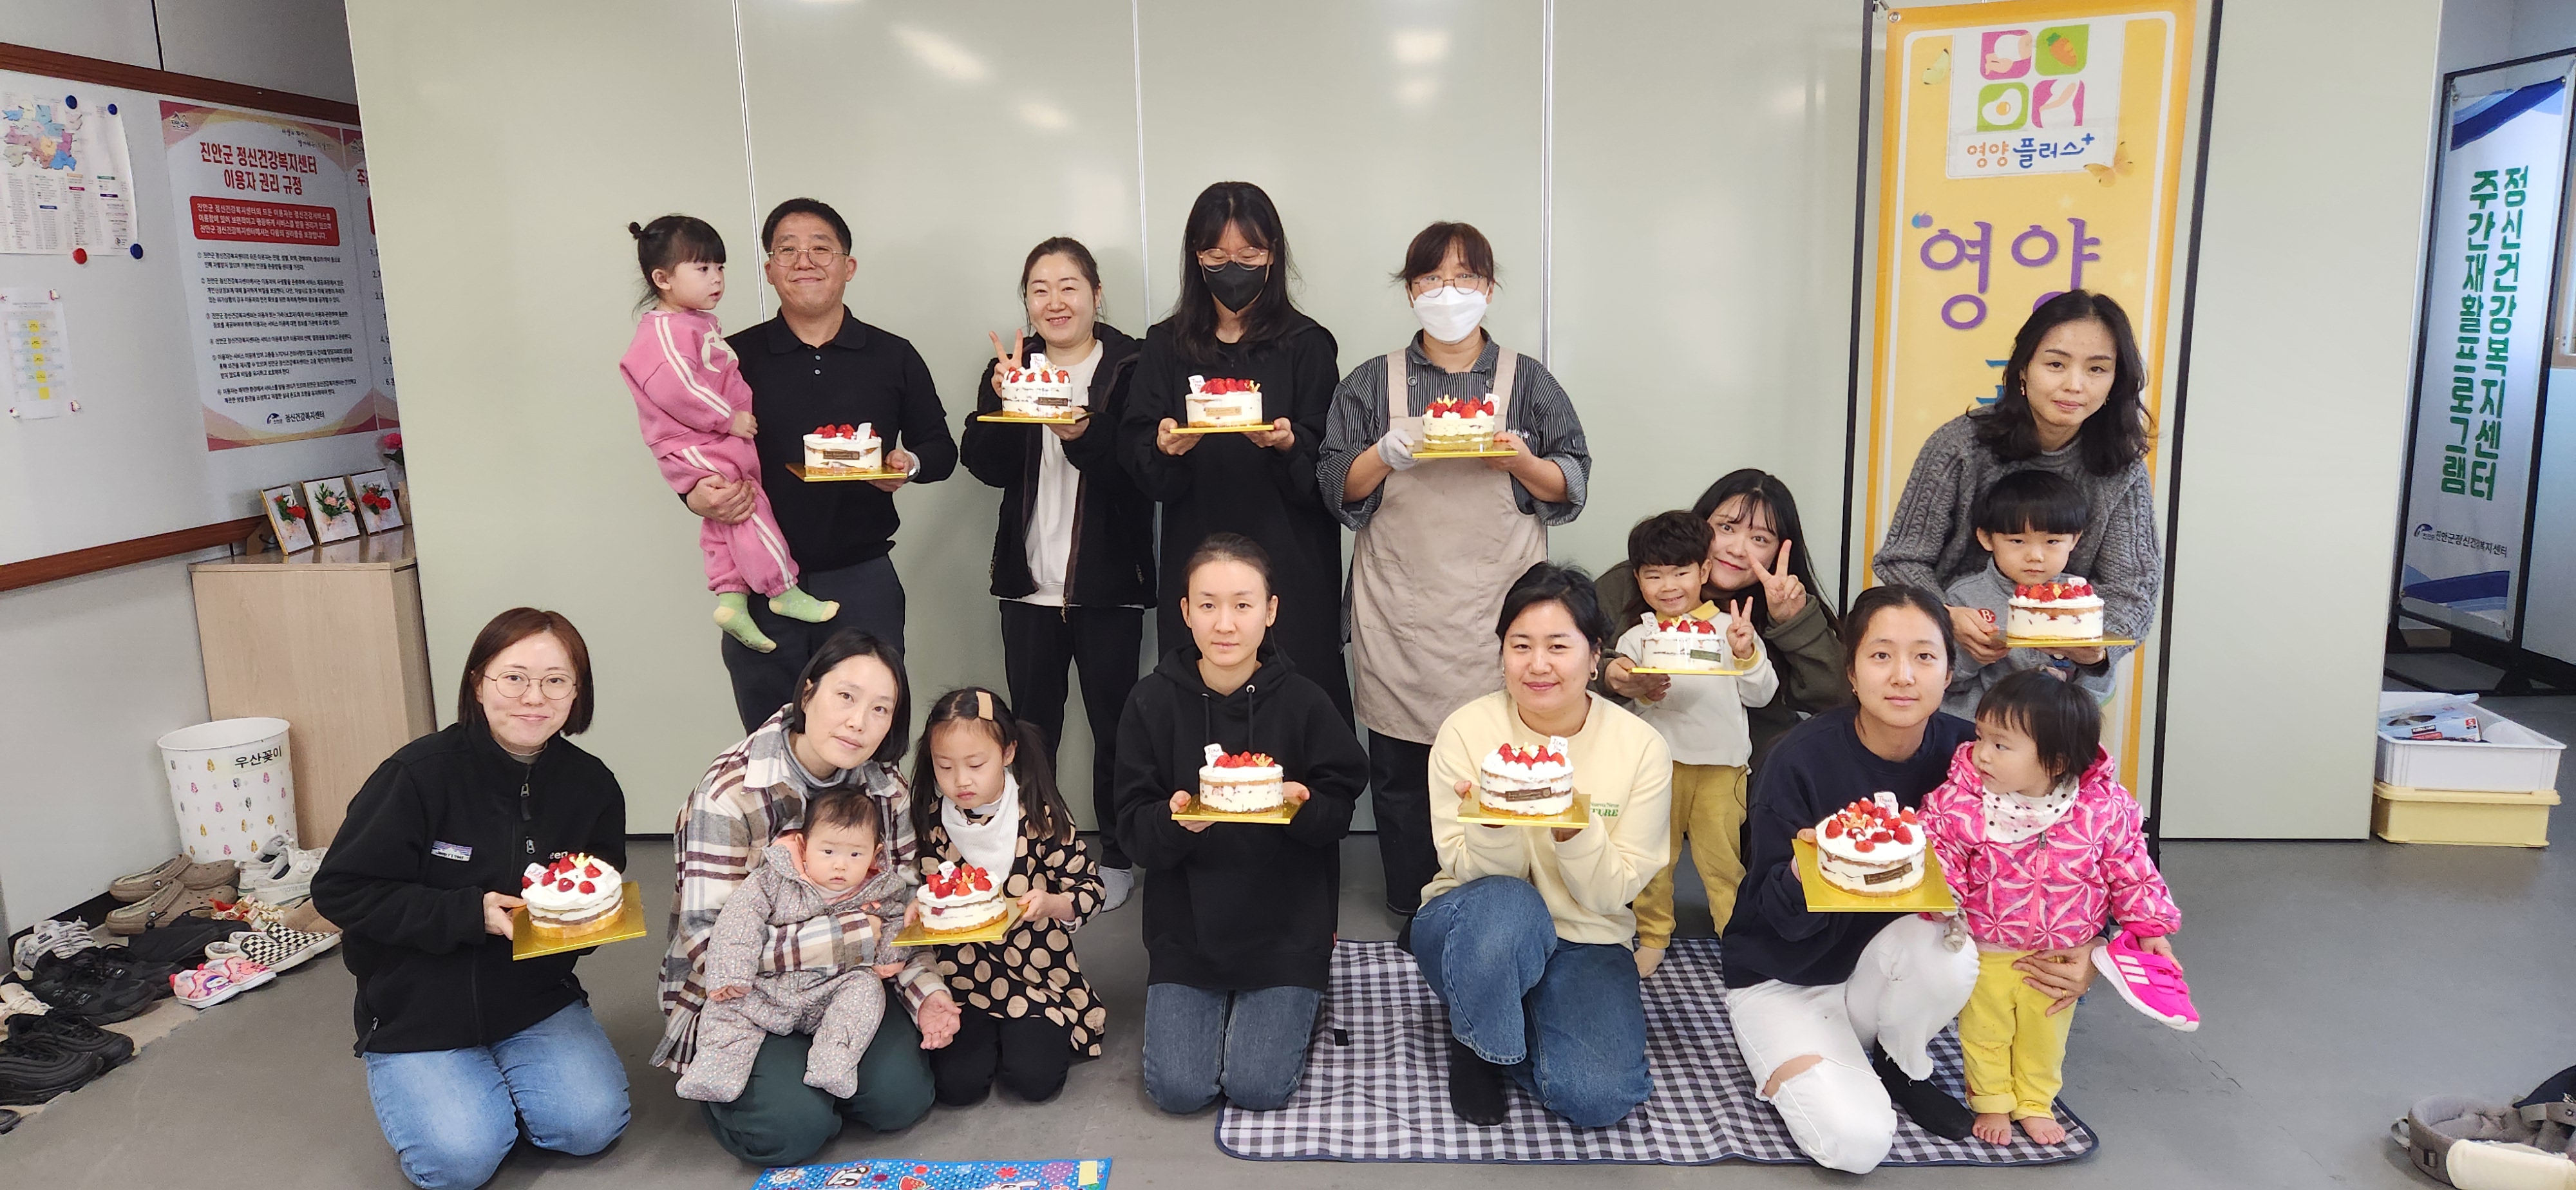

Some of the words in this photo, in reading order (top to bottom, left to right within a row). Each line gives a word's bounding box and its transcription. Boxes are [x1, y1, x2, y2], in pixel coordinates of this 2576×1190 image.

[200, 142, 233, 164] 진안군
[236, 147, 317, 175] 정신건강복지센터
[224, 169, 256, 191] 이용자
[260, 173, 279, 193] 권리
[283, 176, 302, 195] 규정
[197, 203, 213, 212] 진안군
[214, 204, 261, 216] 정신건강복지센터의
[273, 209, 293, 218] 이용자는
[294, 211, 330, 221] 정신건강서비스를
[200, 225, 216, 234] 진안군
[2441, 169, 2499, 495] 주간재활프로그램
[2470, 165, 2528, 501] 정신건강복지센터
[285, 411, 325, 423] 정신건강복지센터
[2436, 531, 2507, 558] 진안군정신건강복지센터
[235, 746, 282, 768] 우산꽂이
[1592, 808, 1618, 817] TURE
